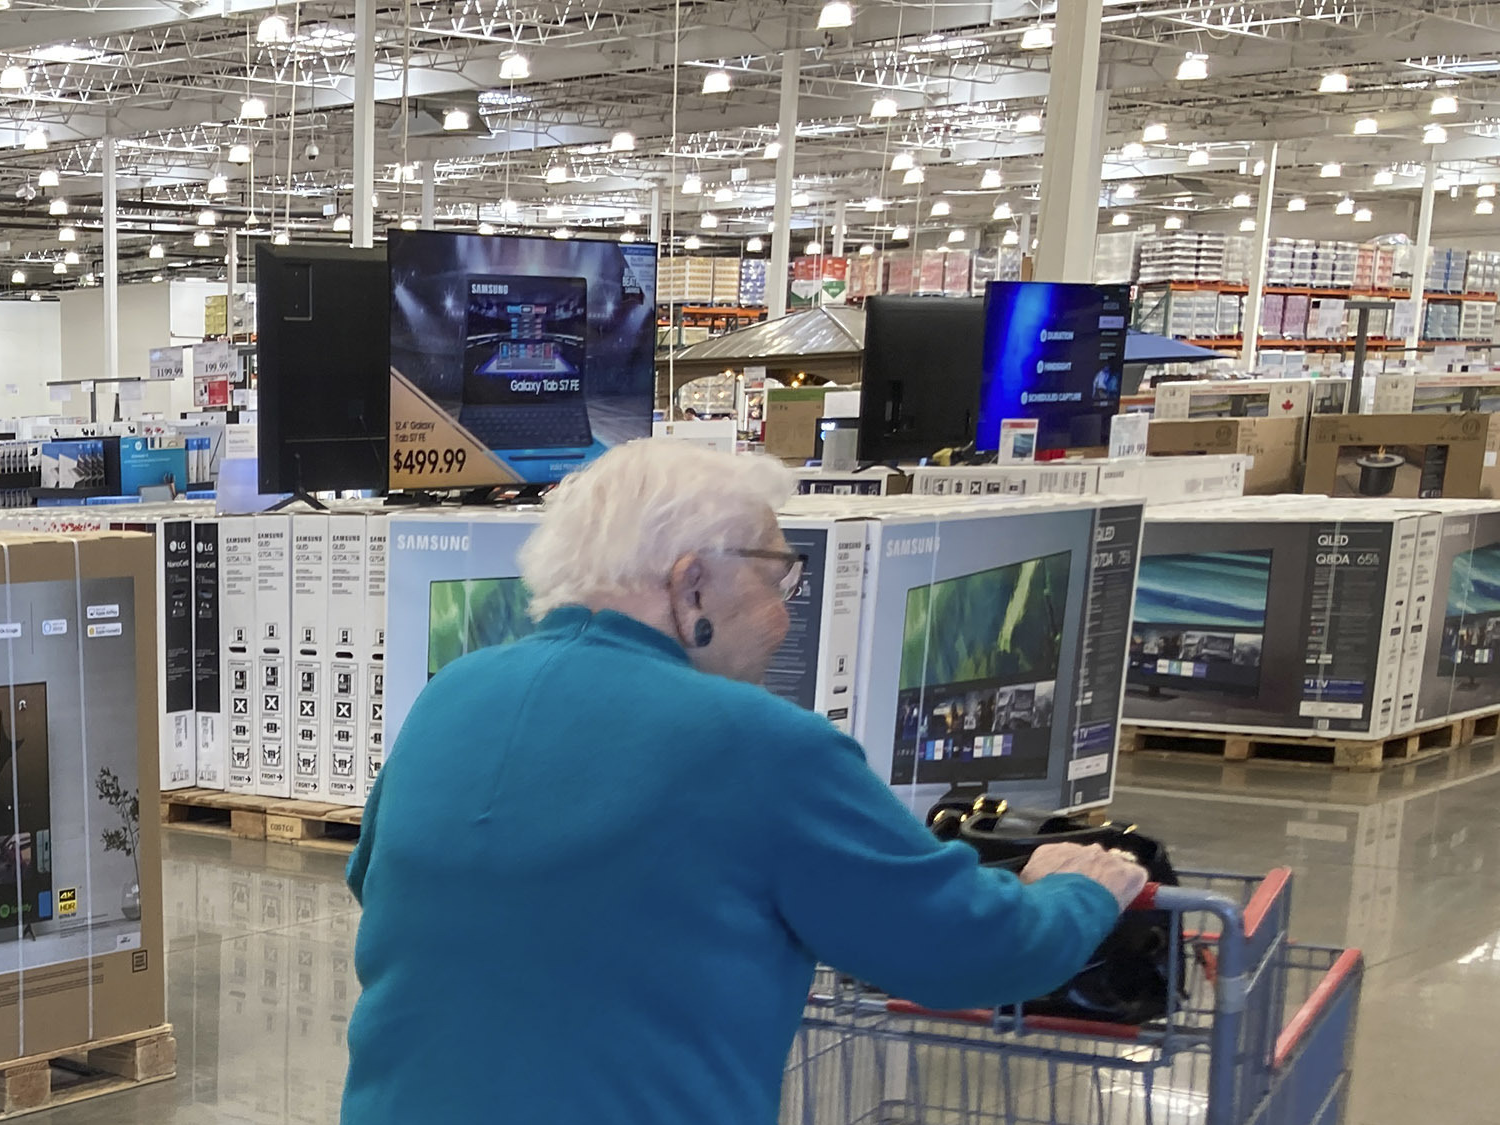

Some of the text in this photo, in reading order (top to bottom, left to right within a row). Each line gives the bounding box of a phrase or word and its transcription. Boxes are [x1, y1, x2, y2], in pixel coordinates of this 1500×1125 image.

[471, 283, 509, 295] SAMSUNG
[510, 379, 541, 396] Galaxy
[542, 379, 558, 392] Tab
[570, 380, 580, 392] FE
[393, 448, 467, 475] $499.99
[177, 541, 187, 550] LG
[396, 534, 470, 552] SAMSUNG
[1317, 534, 1349, 547] QLED
[203, 543, 213, 552] LG
[886, 536, 941, 558] SAMSUNG
[1316, 680, 1329, 689] TV
[59, 890, 75, 900] 4K
[59, 901, 77, 912] HDR
